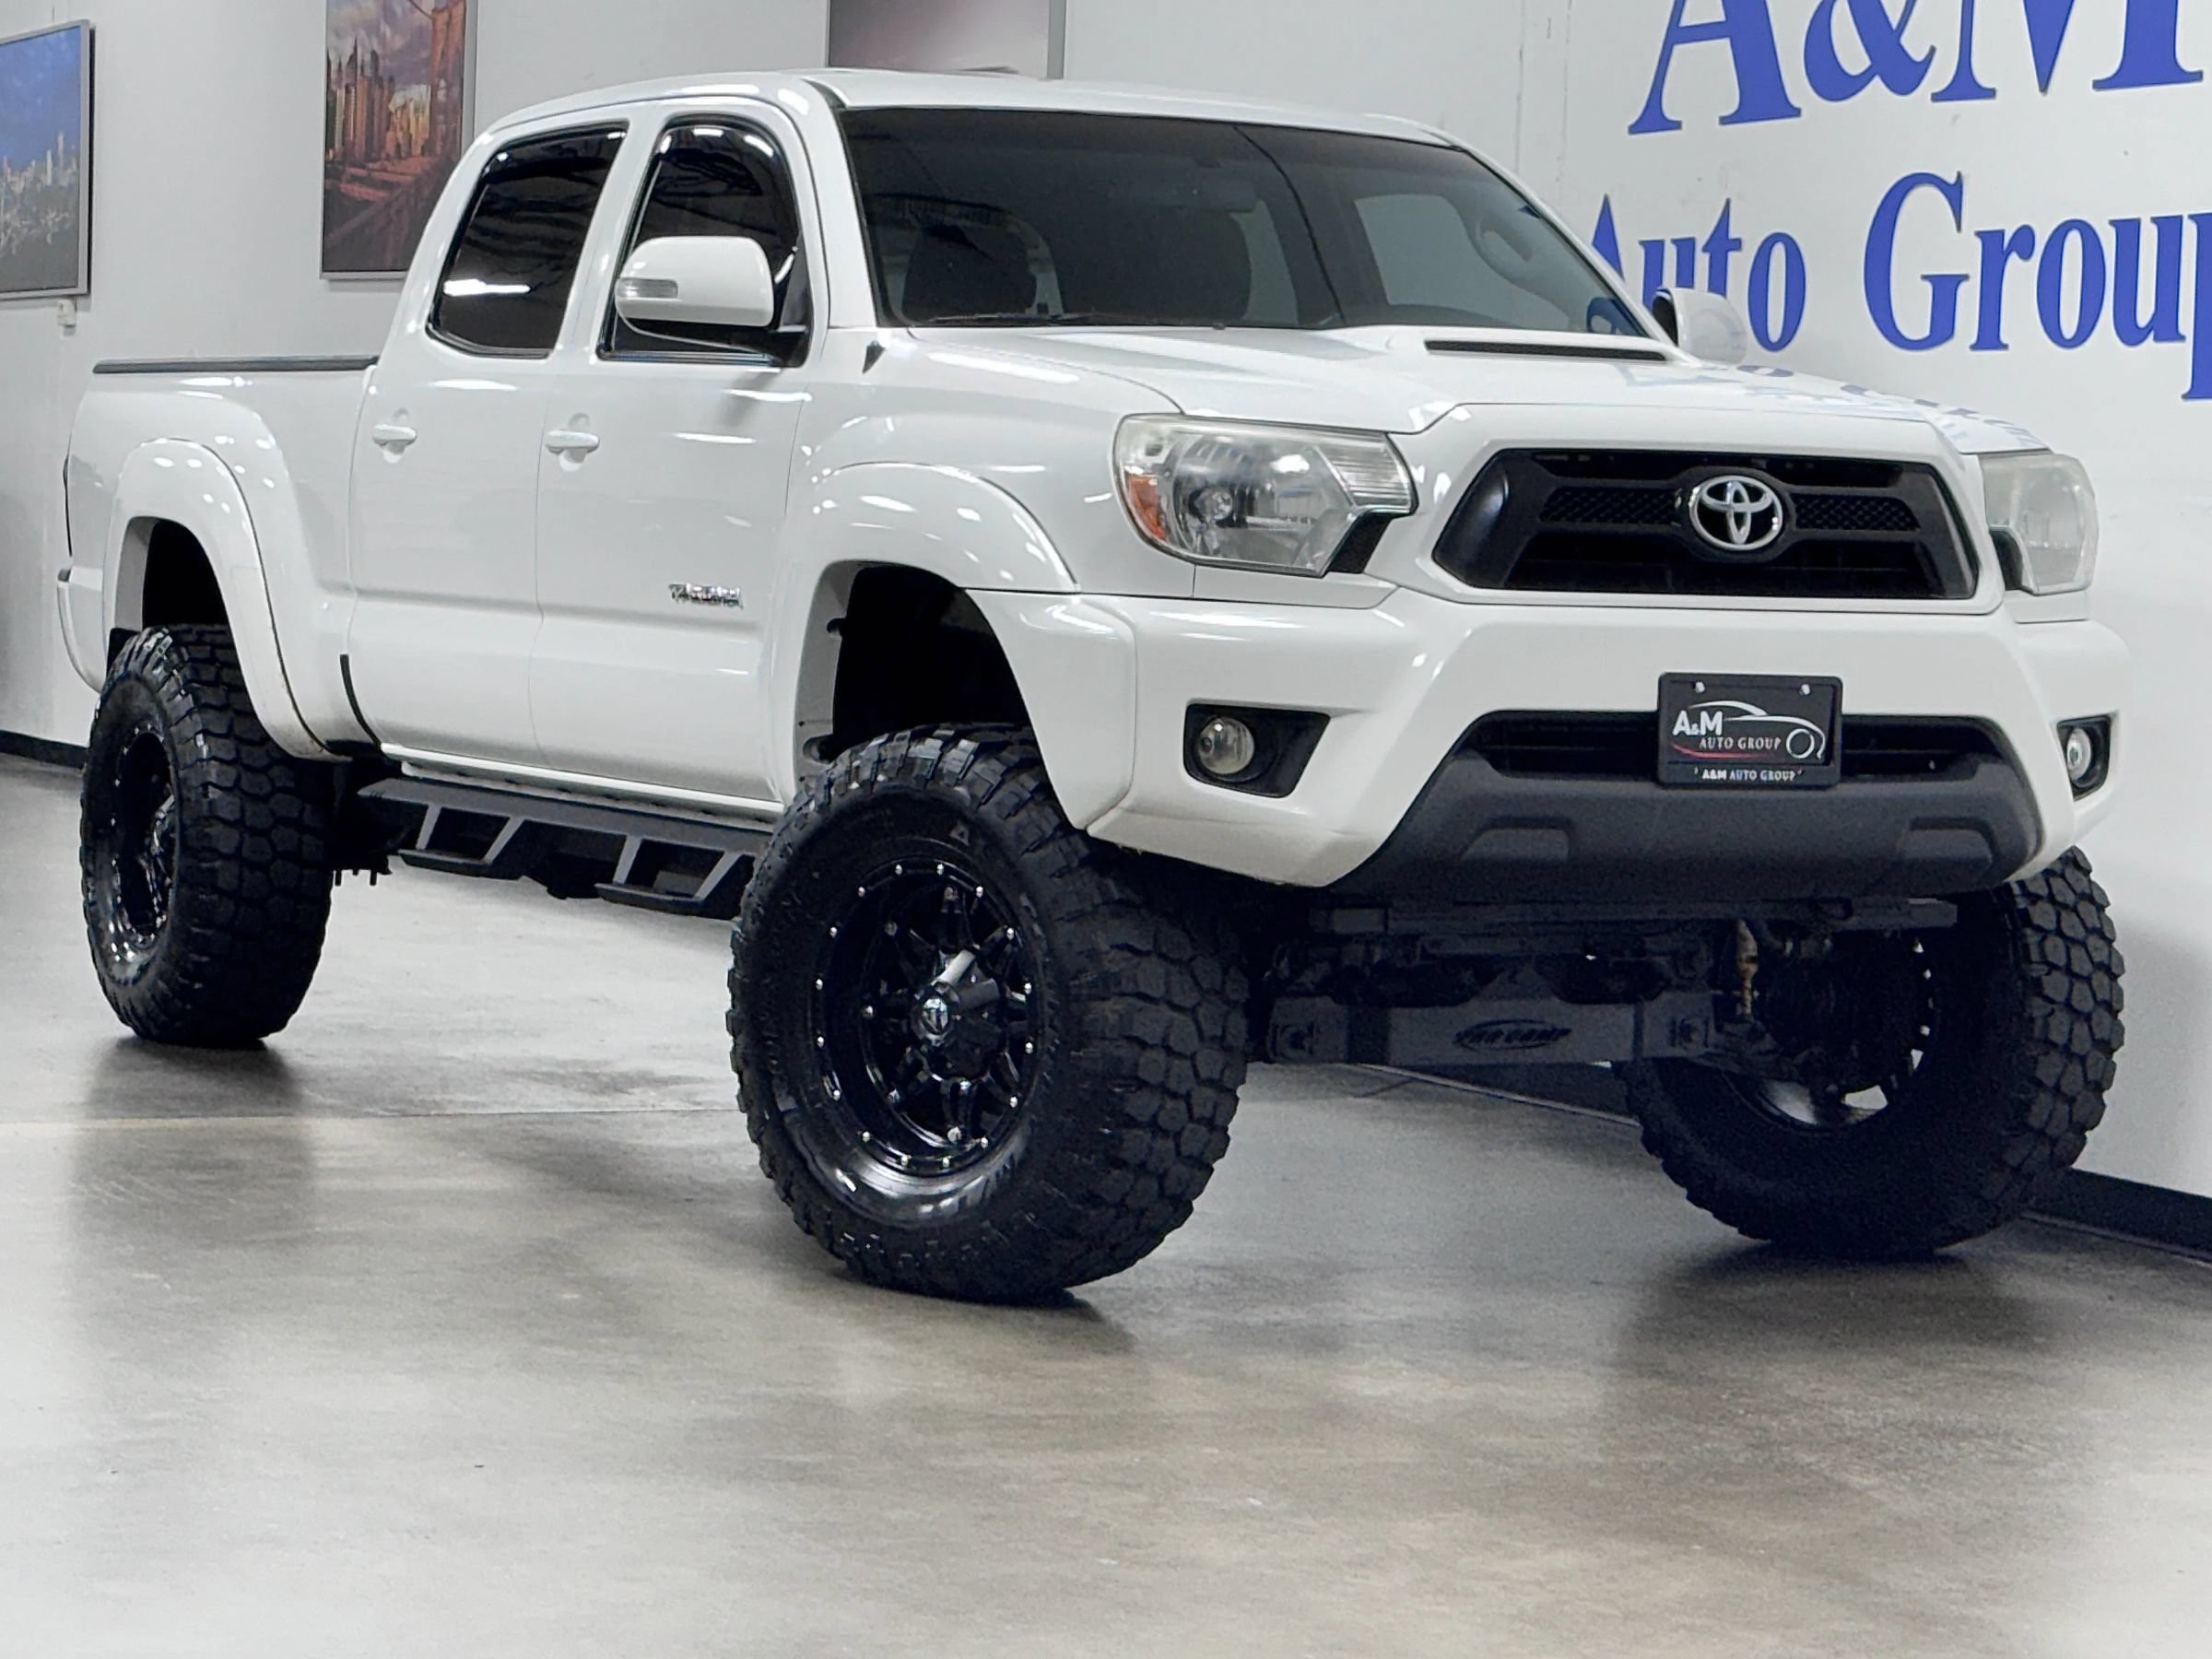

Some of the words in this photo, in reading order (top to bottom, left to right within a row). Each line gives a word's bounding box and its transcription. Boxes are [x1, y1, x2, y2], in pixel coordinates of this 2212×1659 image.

[1672, 710, 1724, 736] A&M
[1699, 736, 1734, 750] AUTO
[1737, 736, 1782, 750] GROUP
[1729, 769, 1757, 782] AUTO
[1759, 769, 1796, 782] GROUP
